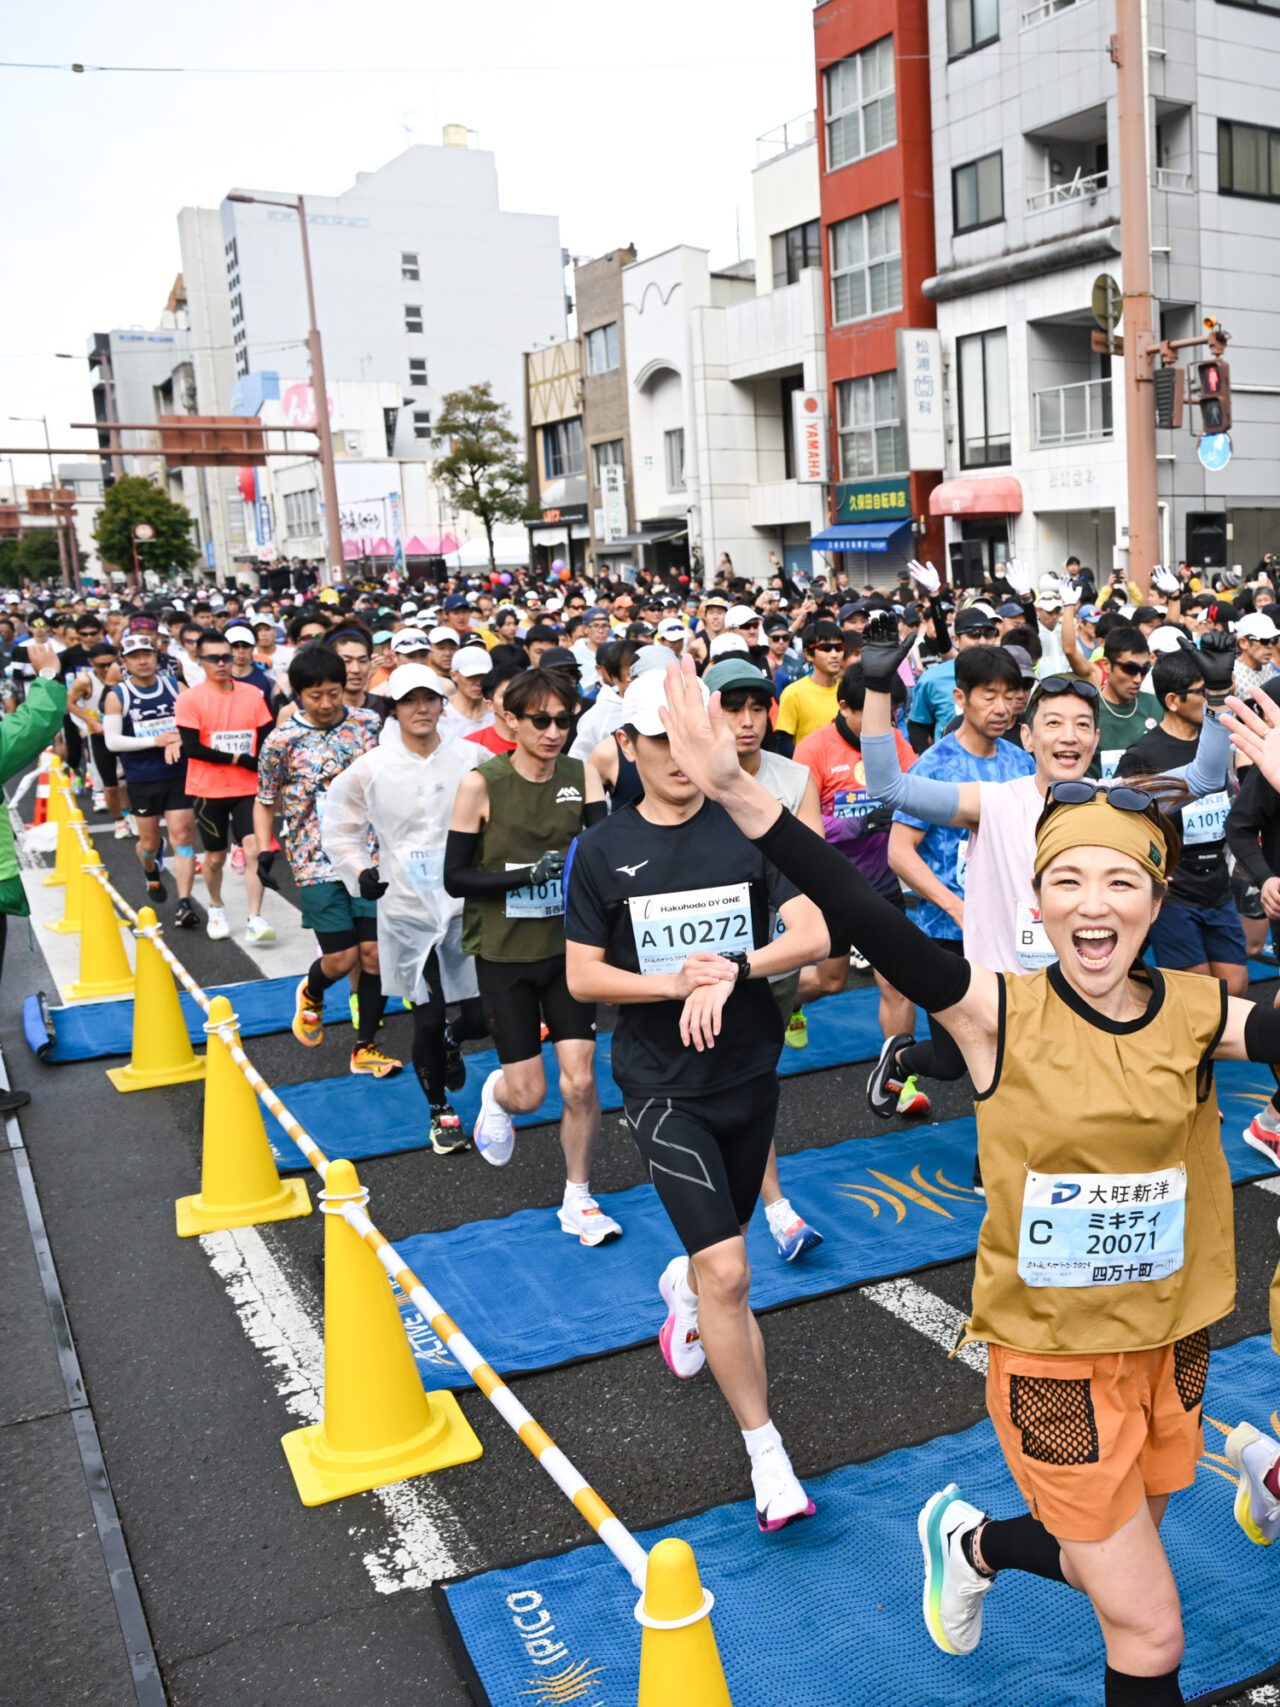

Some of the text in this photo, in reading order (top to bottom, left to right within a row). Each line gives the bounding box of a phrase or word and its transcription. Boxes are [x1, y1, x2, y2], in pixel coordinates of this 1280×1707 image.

[806, 423, 820, 478] YAMAHA
[849, 491, 906, 511] 久保田自転車店
[1105, 768, 1113, 777] A
[1187, 819, 1195, 830] A
[660, 896, 741, 913] Hakuhodo DY ONE
[641, 914, 748, 948] A 10272
[1022, 930, 1034, 945] B
[1088, 1181, 1169, 1204] 大旺新洋
[1029, 1210, 1161, 1244] C ミキティ
[1086, 1231, 1157, 1255] 20071
[1092, 1262, 1153, 1282] 四万十町
[506, 1590, 569, 1666] IPICO
